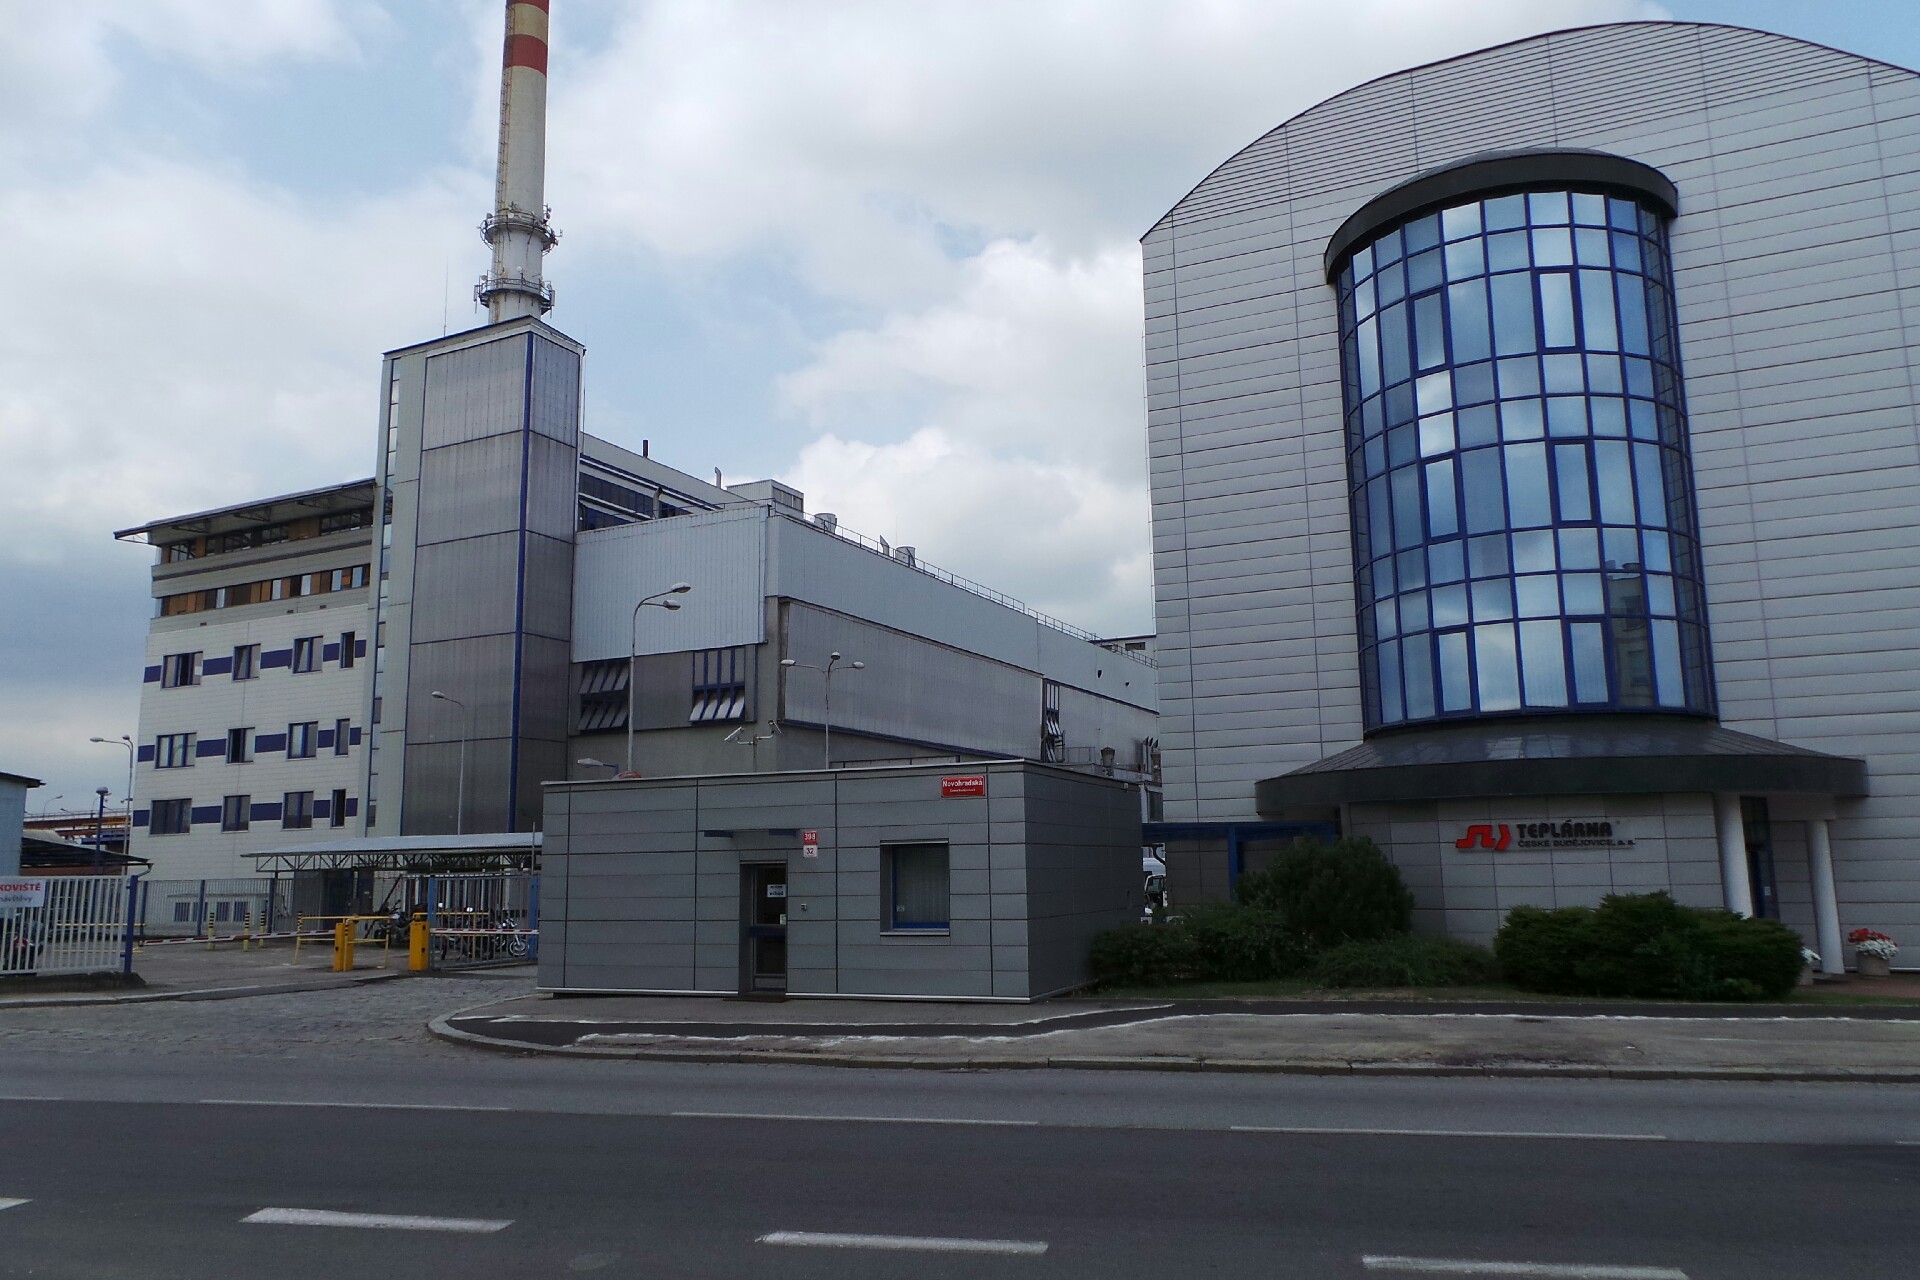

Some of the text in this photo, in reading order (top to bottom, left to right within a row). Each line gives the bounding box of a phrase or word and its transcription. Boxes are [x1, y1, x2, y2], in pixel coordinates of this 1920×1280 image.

[943, 779, 983, 787] Novohradská
[1516, 819, 1613, 839] TEPLÁRNA
[804, 833, 816, 841] 398
[807, 847, 814, 855] 32
